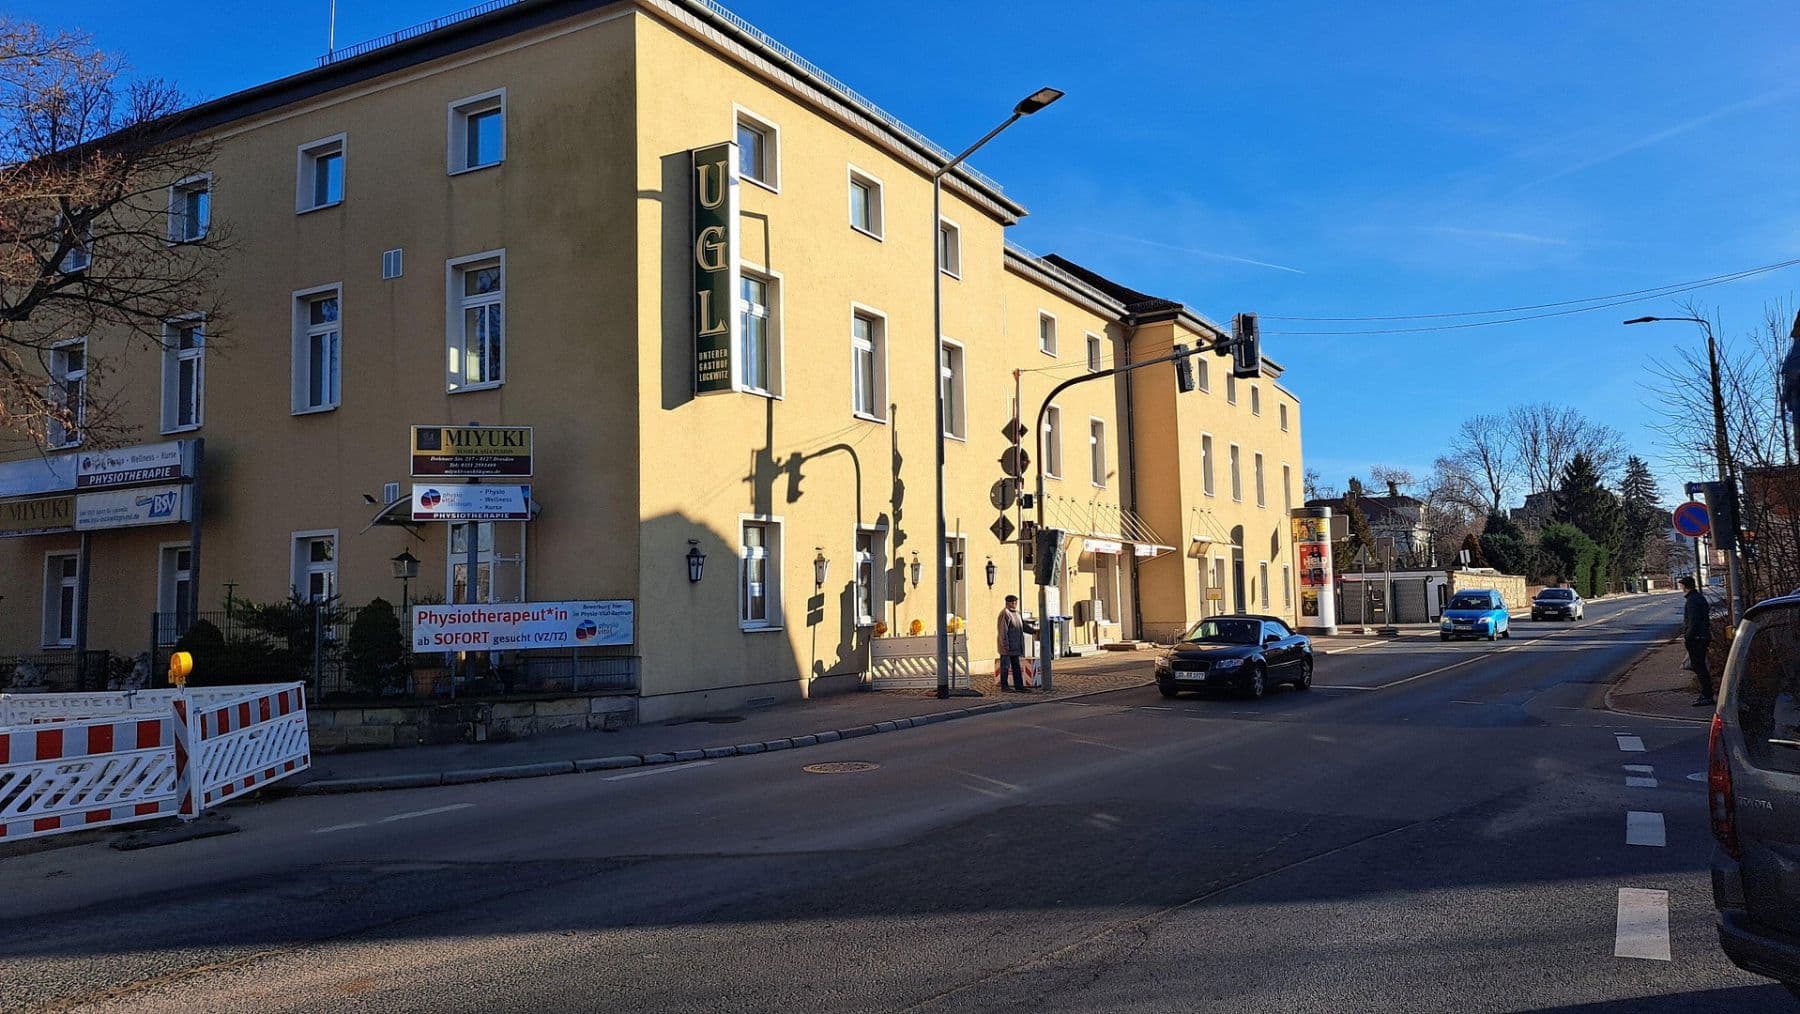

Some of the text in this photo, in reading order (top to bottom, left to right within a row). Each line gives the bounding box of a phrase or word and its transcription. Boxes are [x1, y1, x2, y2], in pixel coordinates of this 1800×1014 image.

[699, 349, 728, 360] UNTERER
[699, 360, 728, 371] GASTHOF
[699, 370, 728, 381] LOCKWITZ
[445, 429, 525, 447] MIYUKI
[89, 467, 171, 485] PHYSIOTHERAPIE
[485, 488, 505, 496] Physio
[154, 493, 177, 514] BSV
[417, 631, 568, 646] ab SOFORT gesucht (VZ/TZ)
